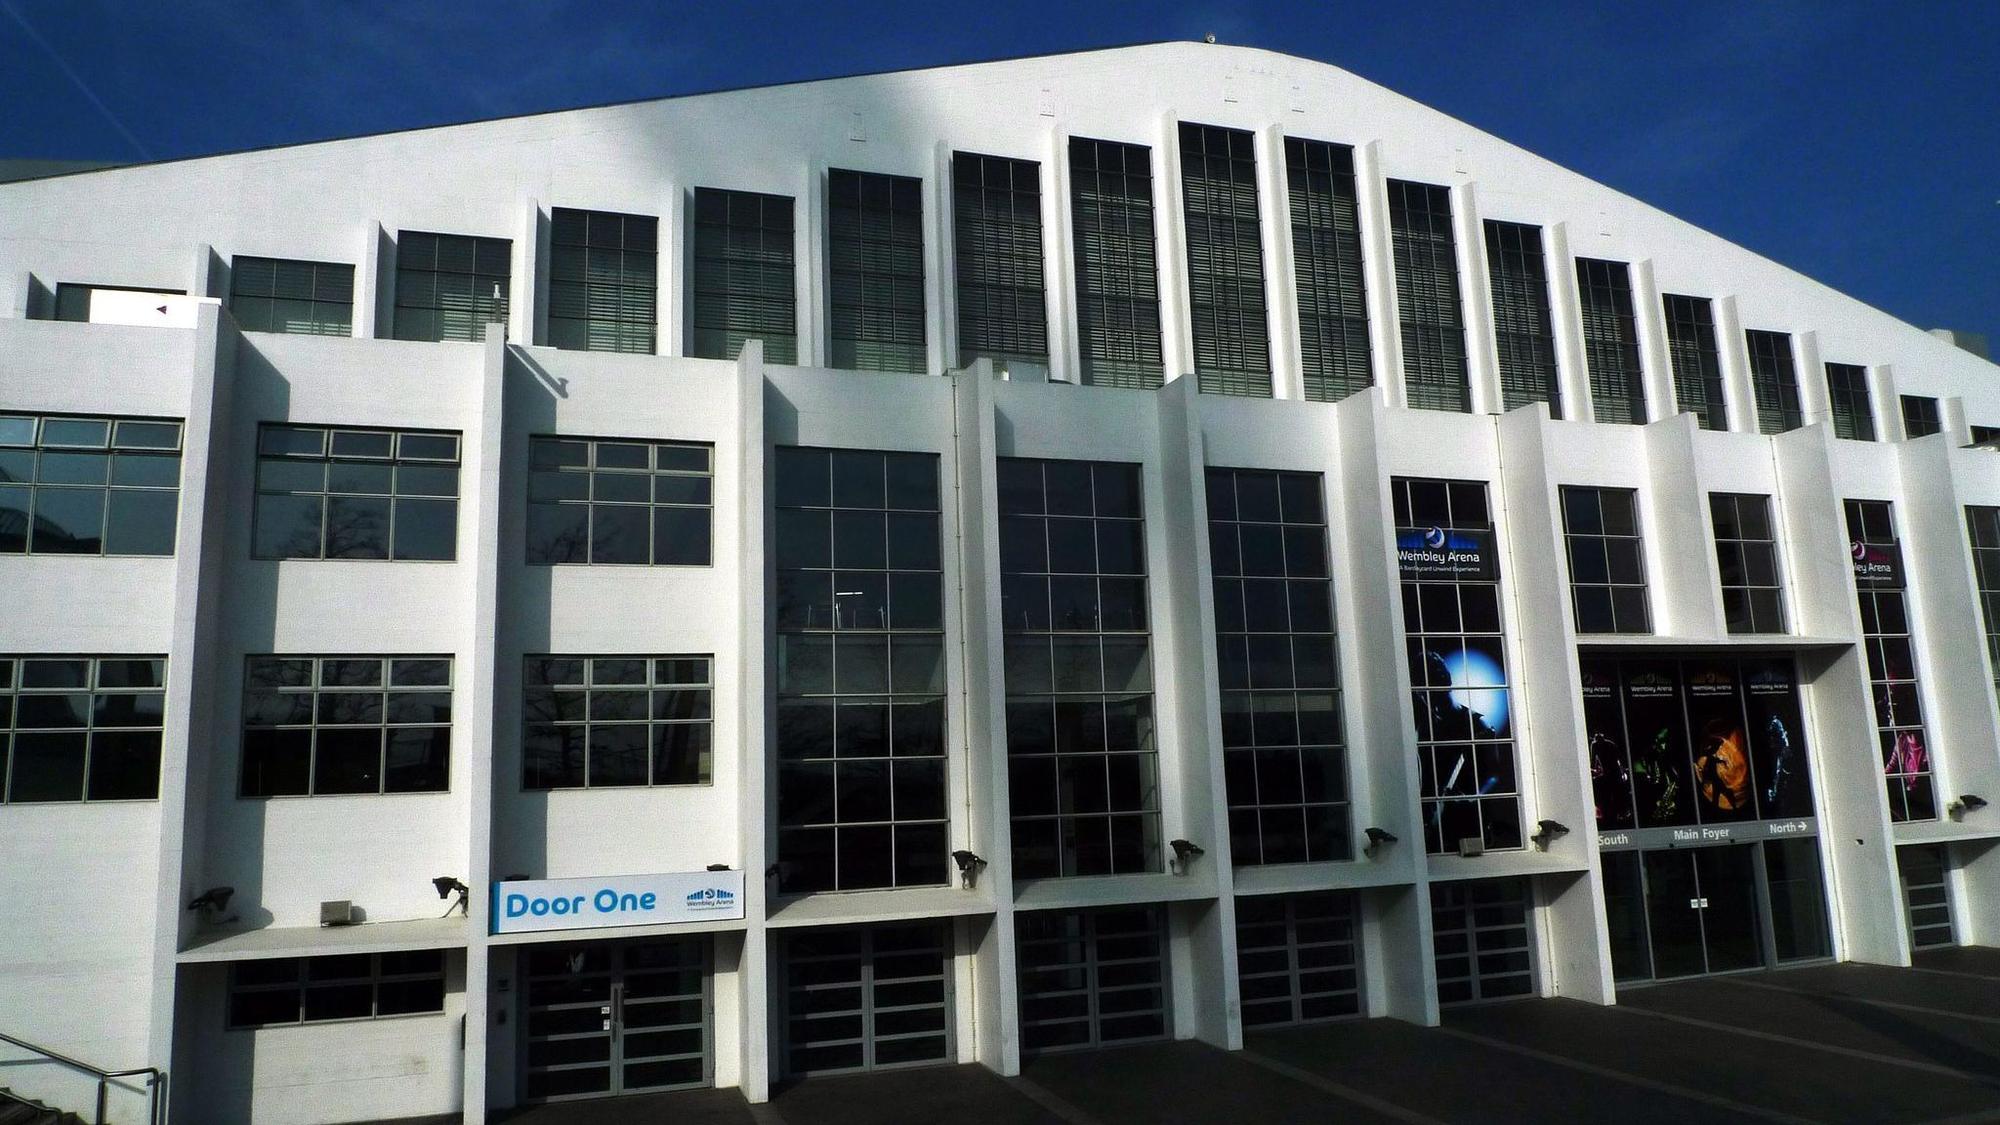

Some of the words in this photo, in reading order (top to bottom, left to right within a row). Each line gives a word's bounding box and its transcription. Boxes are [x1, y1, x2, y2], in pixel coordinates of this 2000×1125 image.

[1399, 550, 1445, 565] Wembley
[1448, 551, 1480, 562] Arena
[1868, 562, 1891, 572] Arena
[1674, 828, 1699, 841] Main
[1703, 827, 1730, 840] Foyer
[1770, 823, 1797, 834] North
[1598, 834, 1629, 847] South
[506, 893, 586, 918] Door
[593, 888, 657, 914] One
